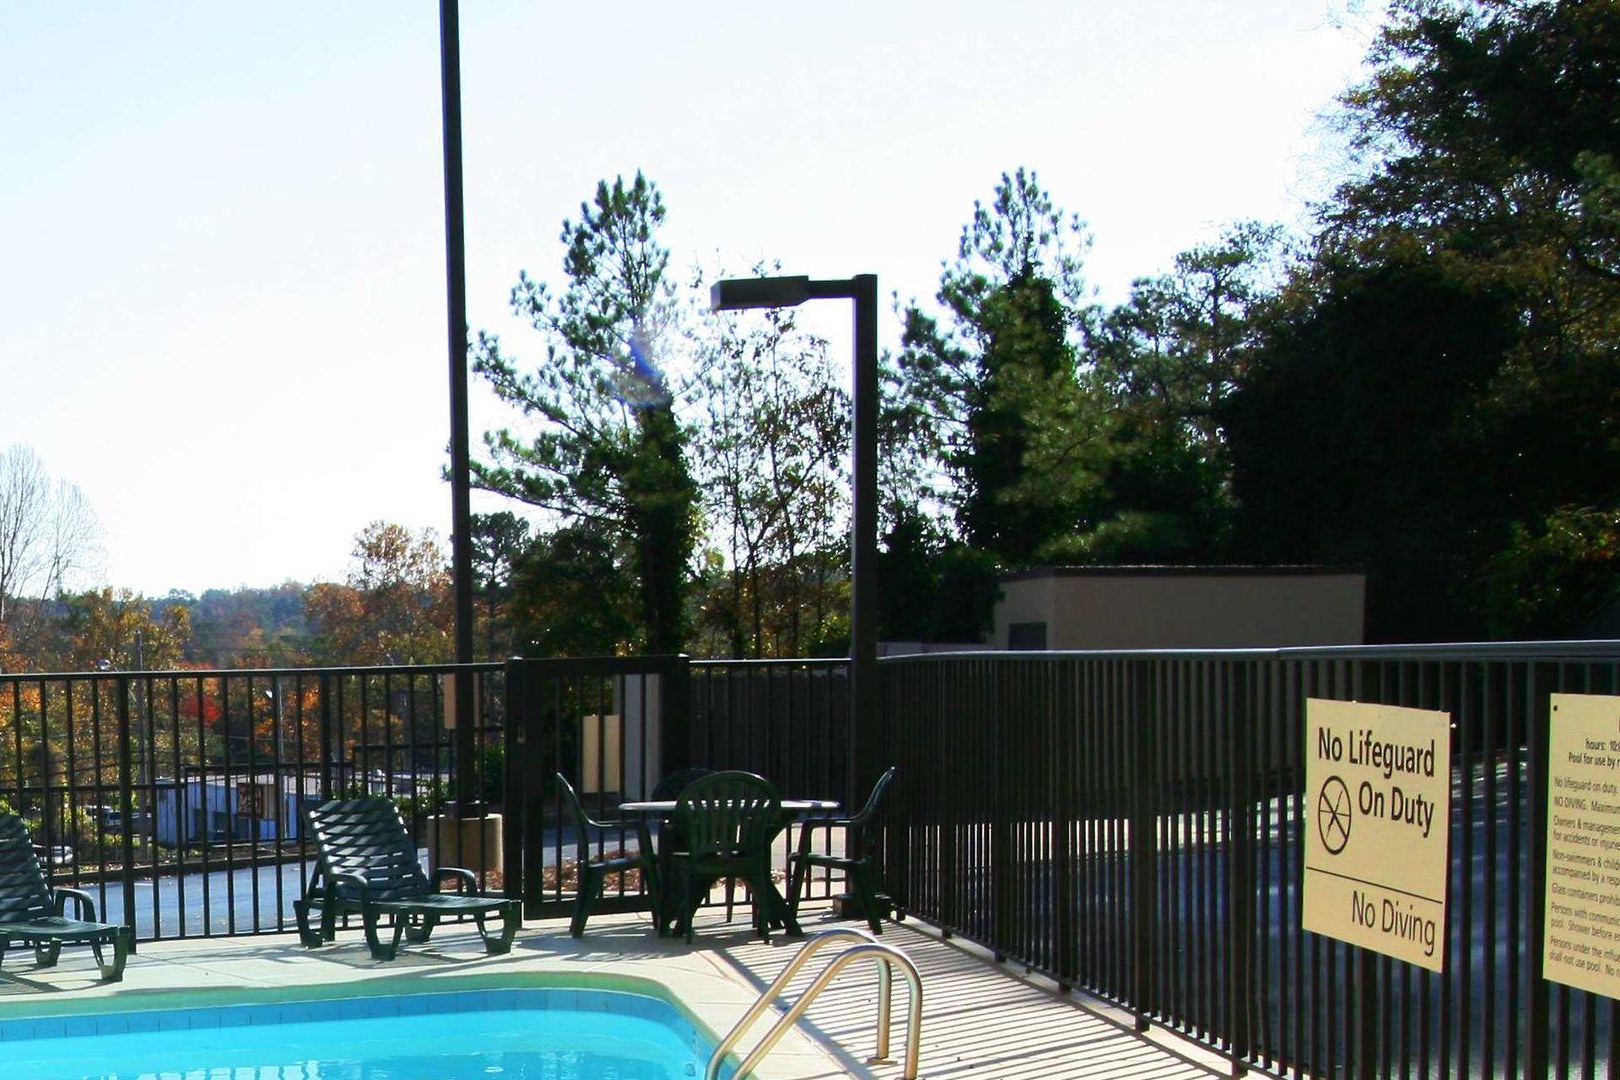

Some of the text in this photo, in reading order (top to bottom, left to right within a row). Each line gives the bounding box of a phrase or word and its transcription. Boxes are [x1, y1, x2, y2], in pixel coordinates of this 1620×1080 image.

[1318, 726, 1434, 779] No Lifeguard
[1568, 751, 1582, 764] Pool
[1583, 752, 1593, 765] for
[1594, 756, 1606, 767] use
[1607, 755, 1616, 770] by
[1554, 776, 1563, 788] No
[1564, 777, 1591, 792] lifeguard
[1592, 783, 1601, 791] on
[1554, 795, 1563, 808] NO
[1358, 781, 1434, 838] On Duty
[1352, 890, 1435, 957] No Diving
